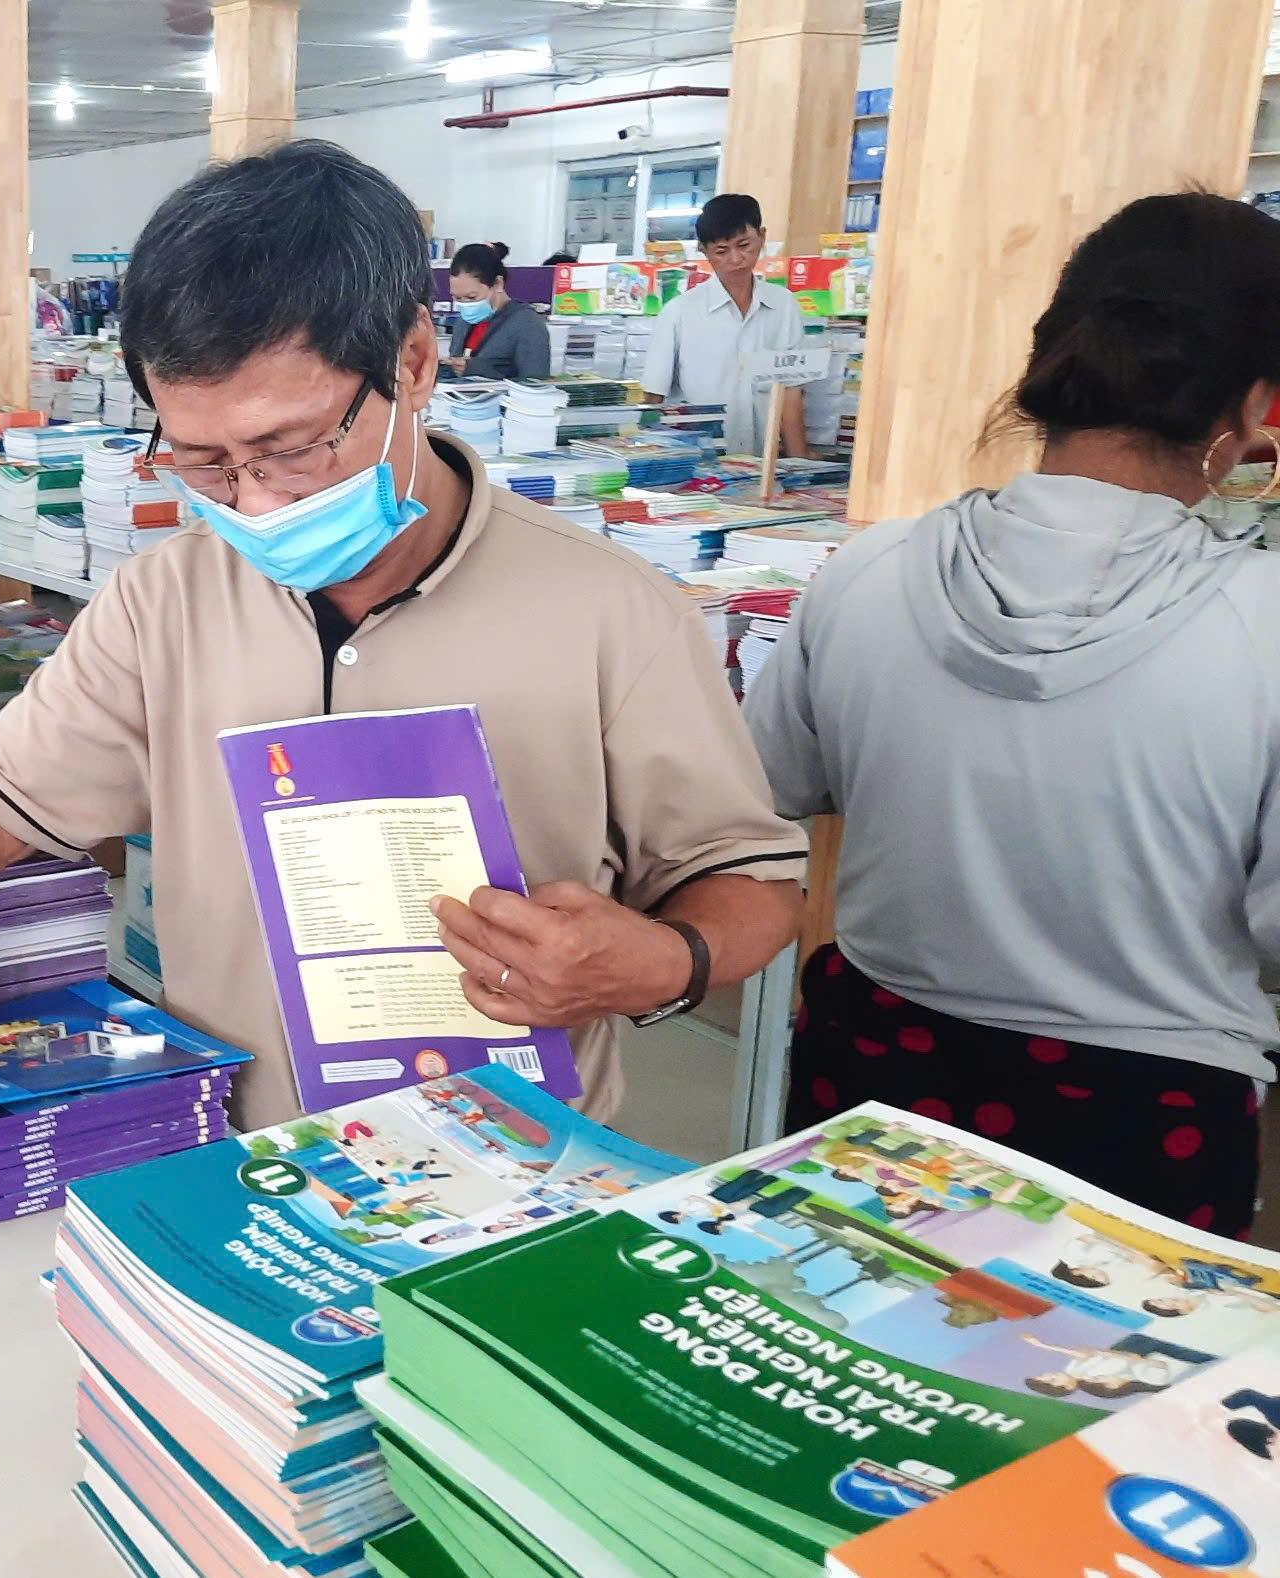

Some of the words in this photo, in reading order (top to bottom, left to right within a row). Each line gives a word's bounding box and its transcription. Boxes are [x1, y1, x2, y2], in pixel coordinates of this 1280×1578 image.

[247, 1163, 300, 1193] 11
[246, 1202, 319, 1250] NGHIỆP
[223, 1239, 286, 1278] ĐỘNG
[306, 1268, 360, 1295] TRẢI
[631, 1238, 699, 1274] 11
[274, 1274, 336, 1304] HOẠT
[638, 1312, 761, 1384] ĐỘNG
[678, 1296, 841, 1391] NGHIỆM,
[703, 1285, 854, 1364] NGHIỆP
[751, 1381, 881, 1441] HOẠT
[832, 1383, 941, 1437] TRẢI
[847, 1358, 1026, 1434] HƯỚNG
[1127, 1490, 1225, 1558] 11
